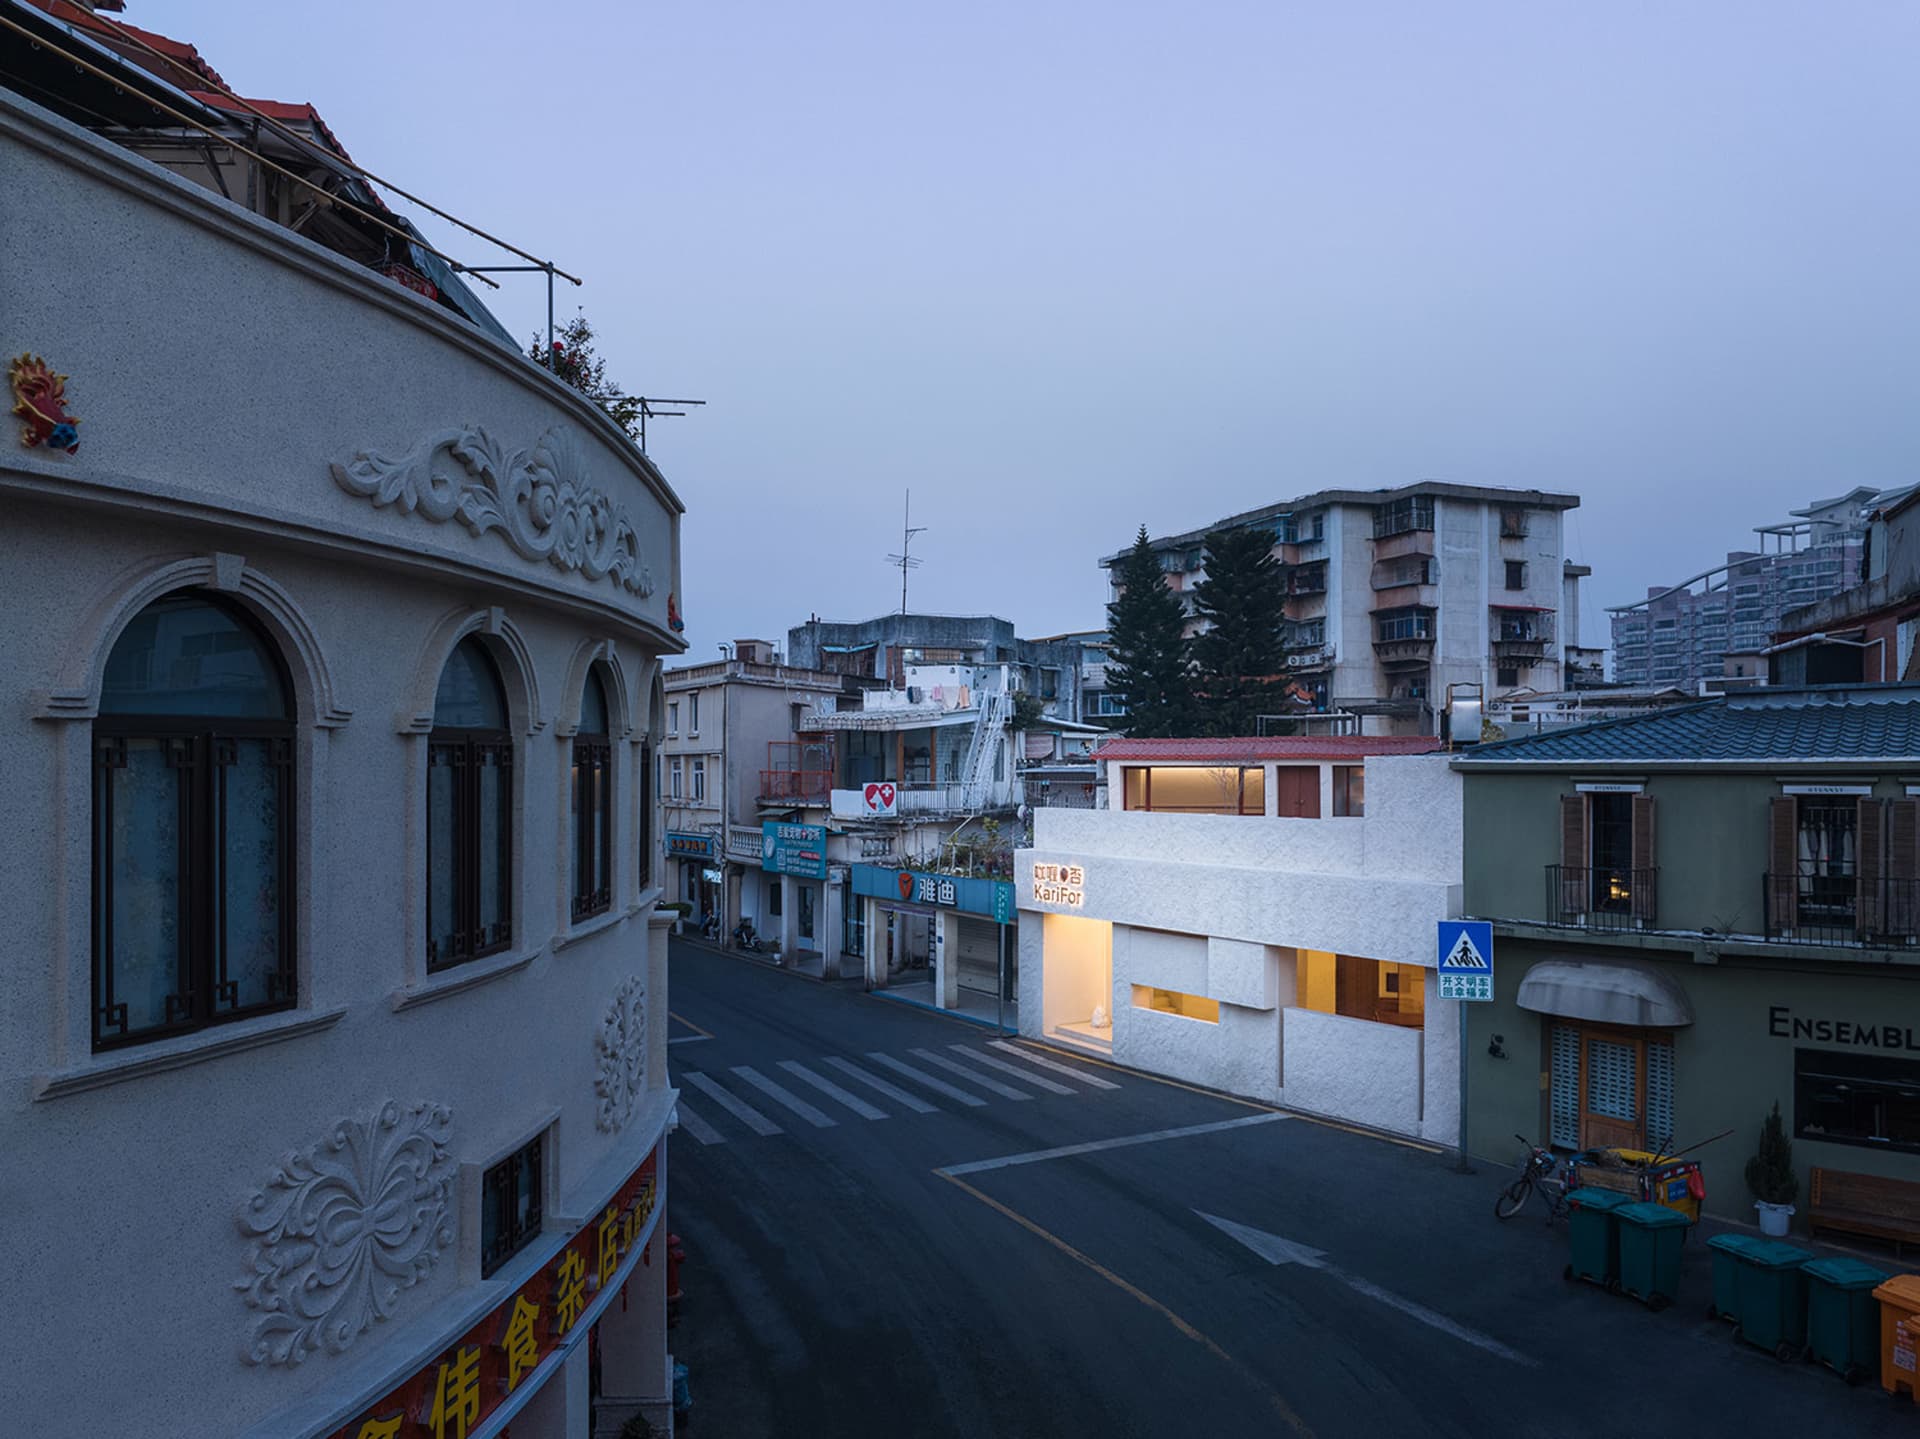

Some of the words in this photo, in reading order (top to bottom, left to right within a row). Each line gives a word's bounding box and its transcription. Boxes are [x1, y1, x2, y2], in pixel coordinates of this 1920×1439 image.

[918, 878, 955, 905] 雅迪
[1034, 884, 1082, 905] KariFor
[1442, 976, 1489, 987] 开文明车
[1443, 987, 1489, 998] 回幸福家
